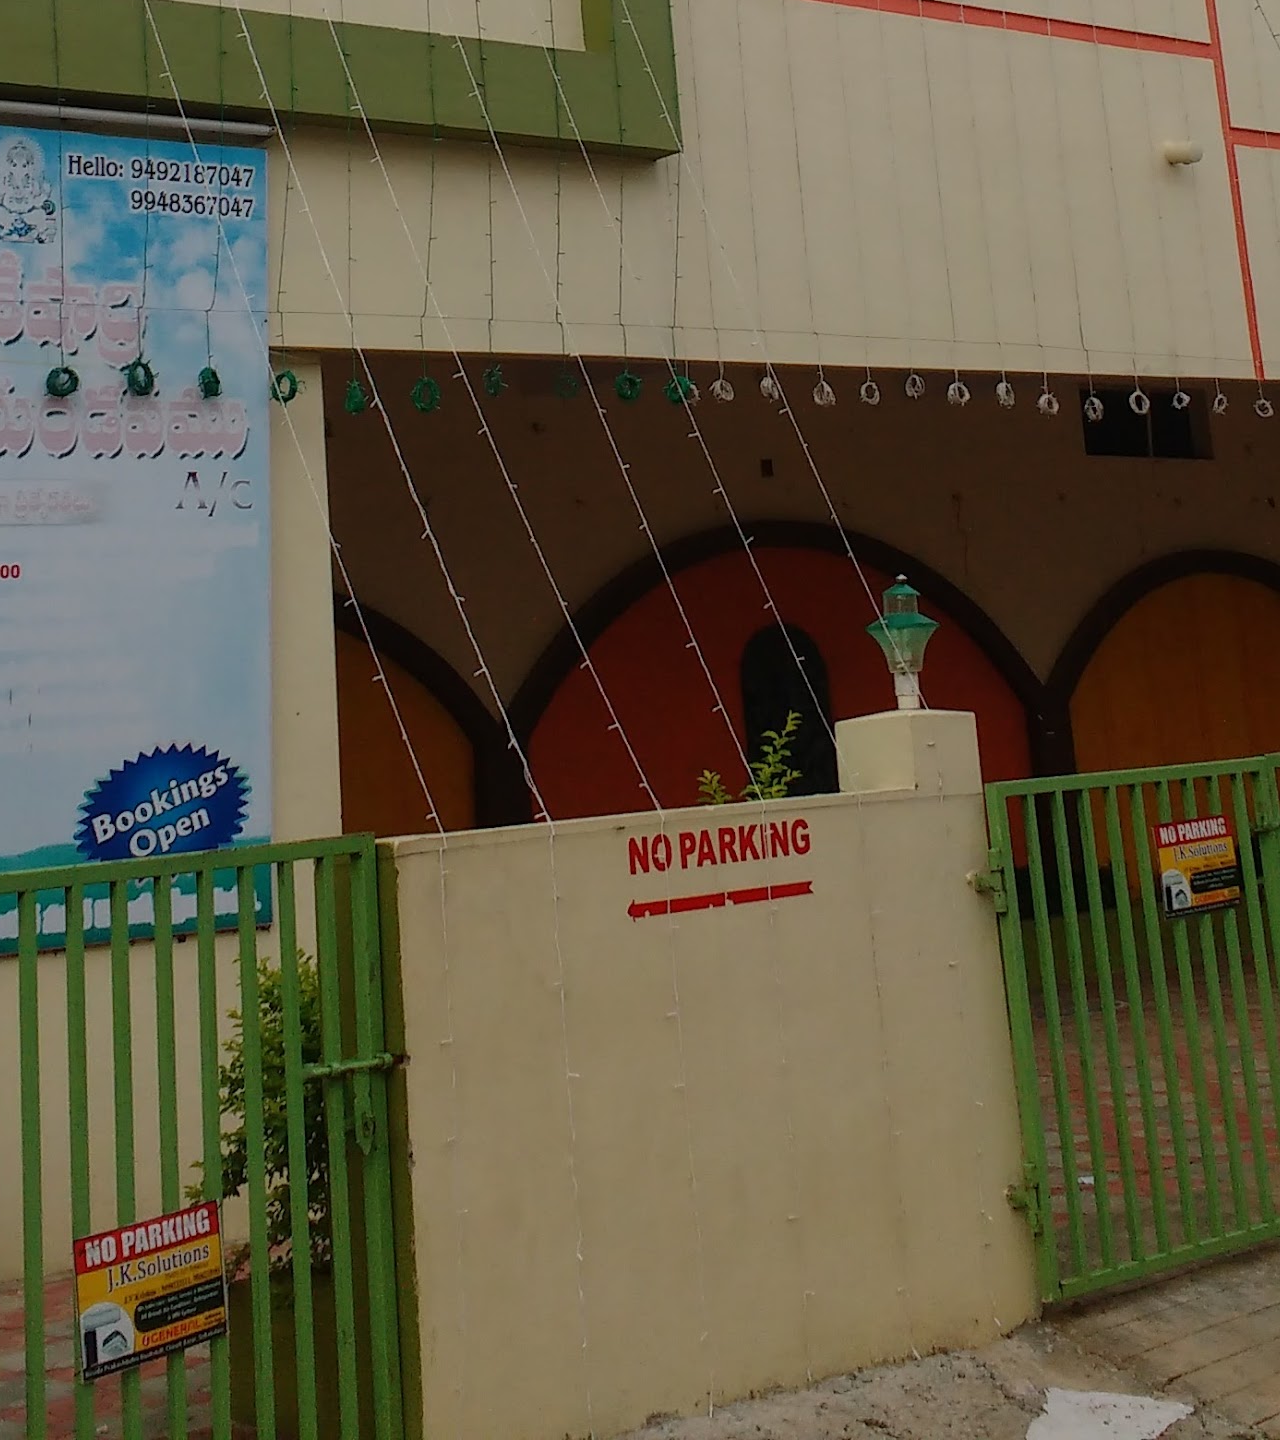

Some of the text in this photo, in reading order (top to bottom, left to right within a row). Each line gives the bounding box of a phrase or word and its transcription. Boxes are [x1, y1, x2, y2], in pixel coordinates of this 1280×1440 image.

[67, 154, 253, 188] Hello: 9492187047
[130, 190, 253, 219] 9948367047
[91, 762, 229, 844] Bookings
[128, 806, 211, 857] Open
[628, 818, 811, 875] NO PARKING
[1158, 817, 1227, 845] NO PARKING
[85, 1208, 211, 1268] NO PARKING
